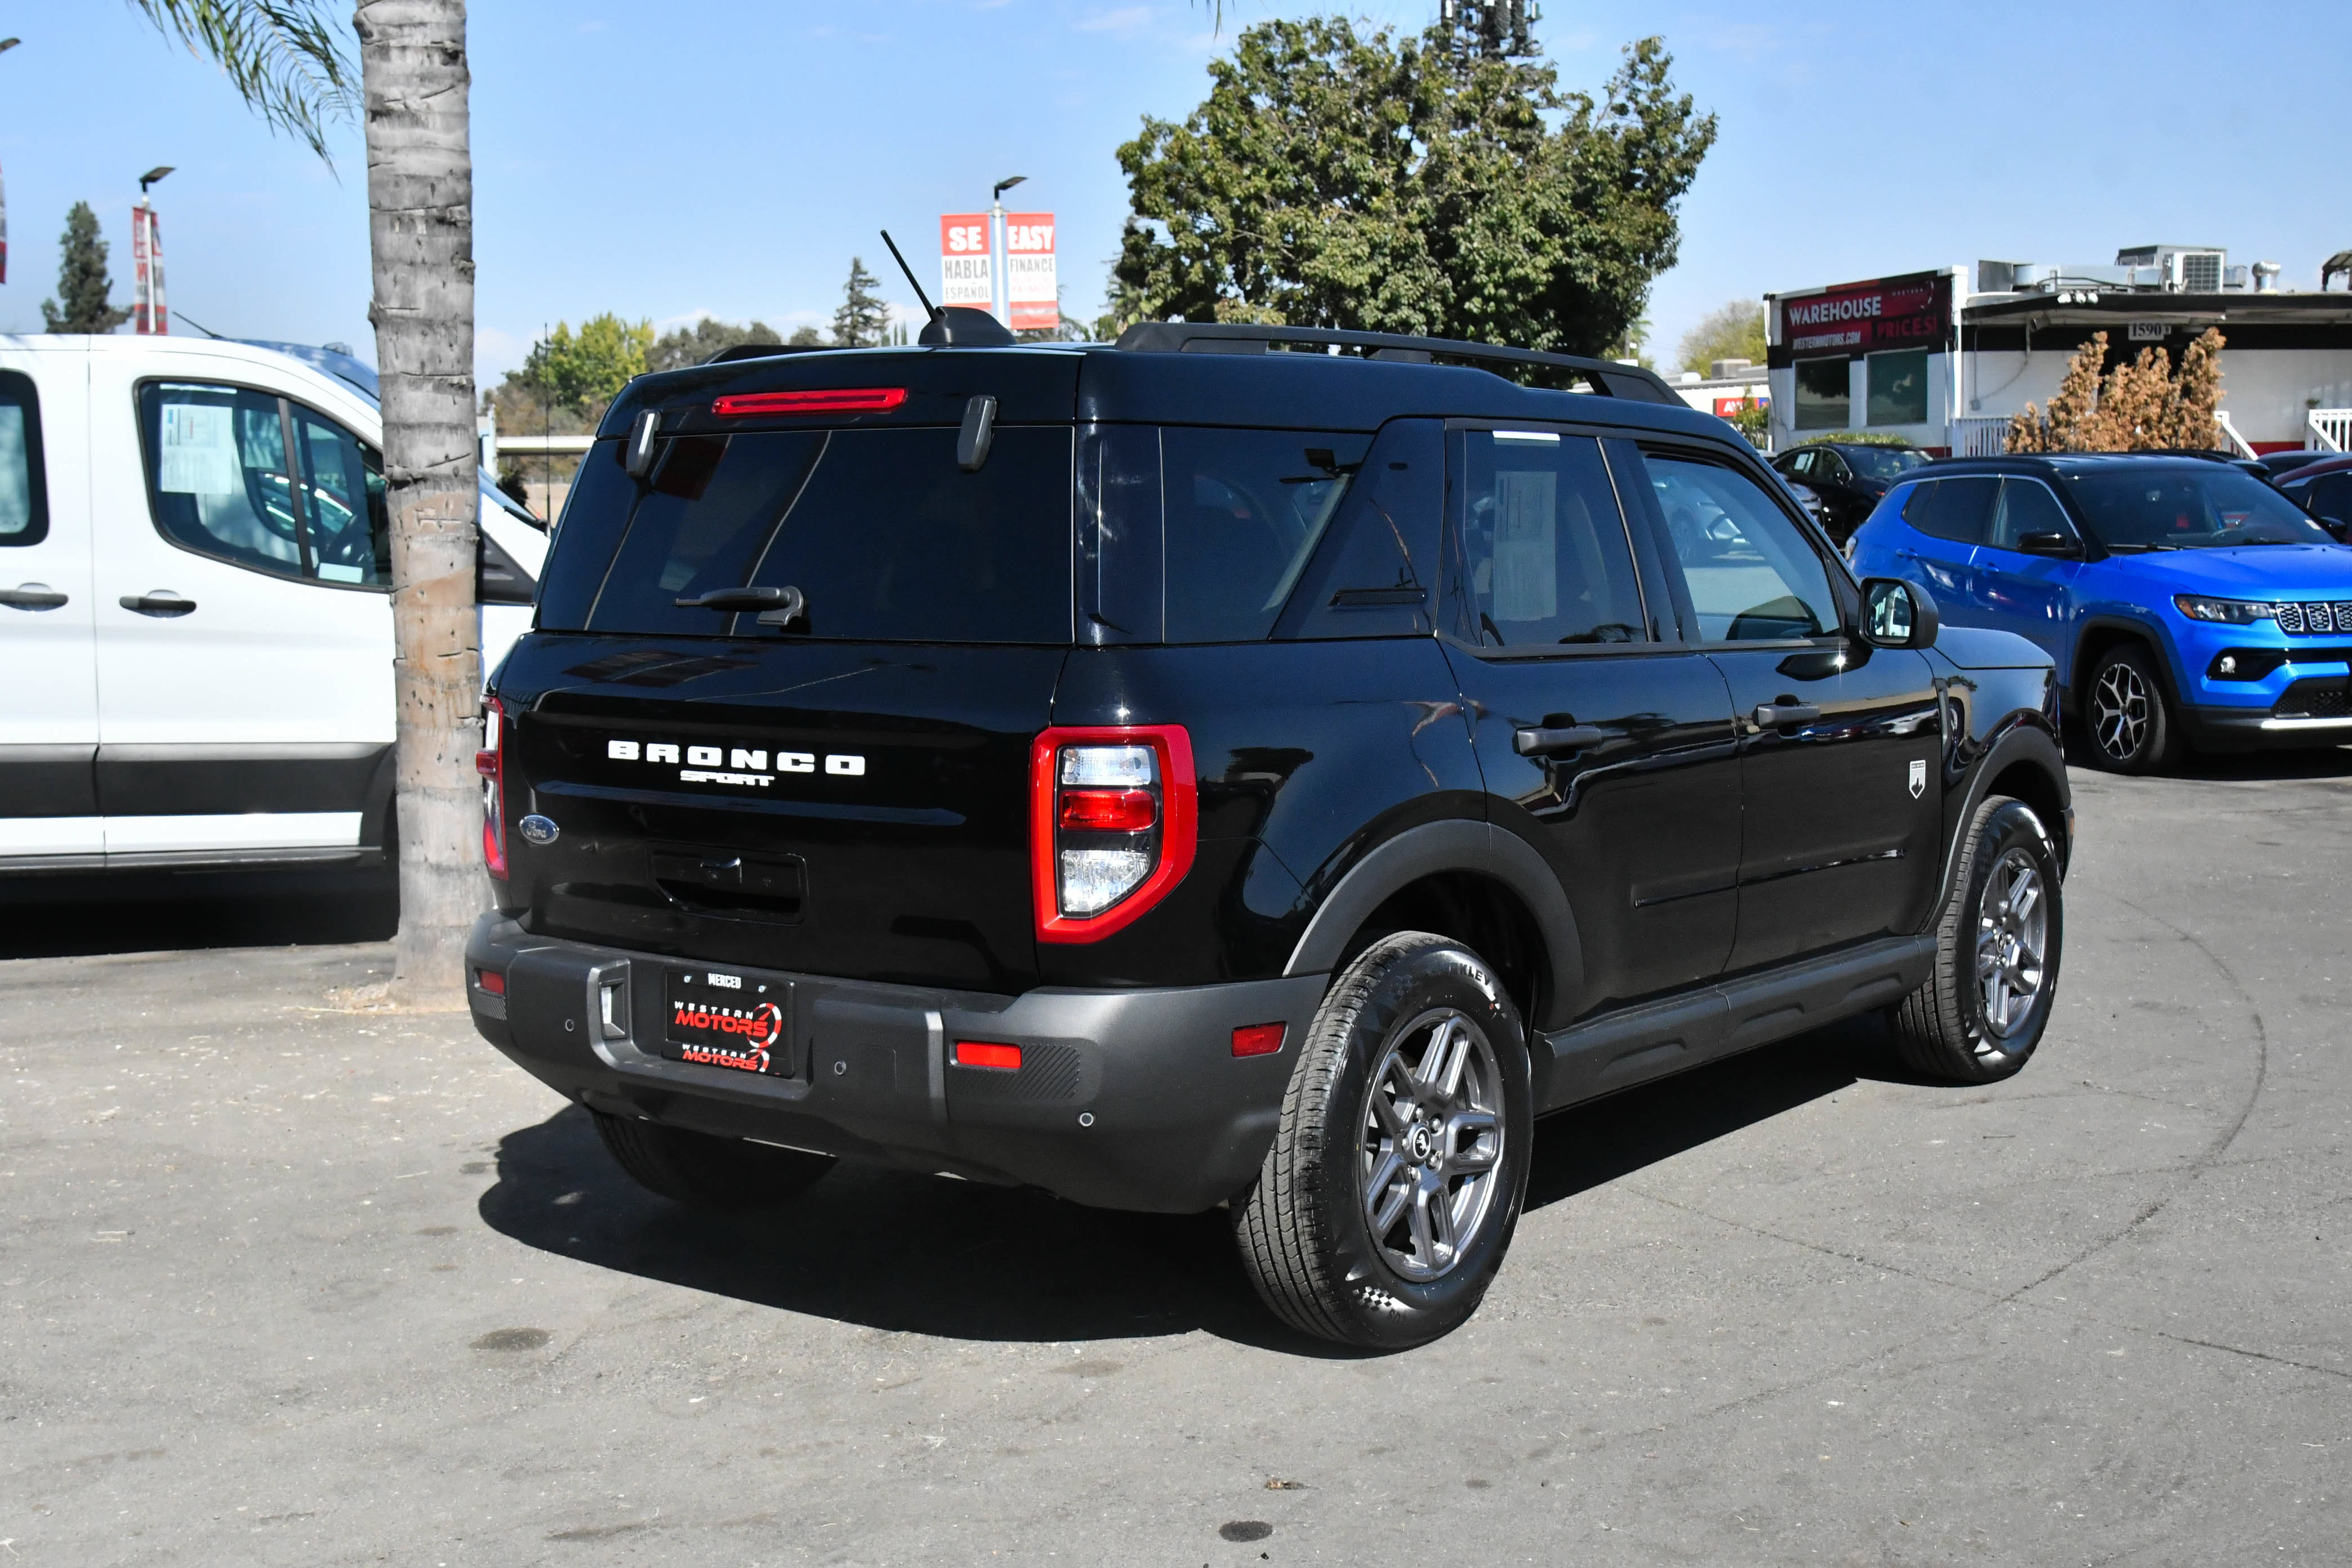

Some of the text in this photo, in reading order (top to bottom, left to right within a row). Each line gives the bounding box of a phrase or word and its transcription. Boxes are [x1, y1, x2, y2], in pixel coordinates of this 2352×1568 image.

[948, 226, 983, 251] SE
[1008, 226, 1053, 251] EASY
[945, 259, 988, 279] HABLA
[1010, 258, 1053, 273] FINANCE
[946, 282, 989, 300] ESPAÑOL
[1789, 295, 1882, 327] WAREHOUSE
[1877, 315, 1937, 337] PRICES!
[2132, 323, 2161, 337] 1590
[608, 740, 865, 775] BRONCO
[680, 770, 776, 786] SPORT
[708, 973, 741, 989] MERCED
[674, 1001, 754, 1020] WESTERN
[675, 1009, 768, 1037] MOTORS
[682, 1044, 747, 1059] WESTERN
[683, 1050, 758, 1071] MOTORS
